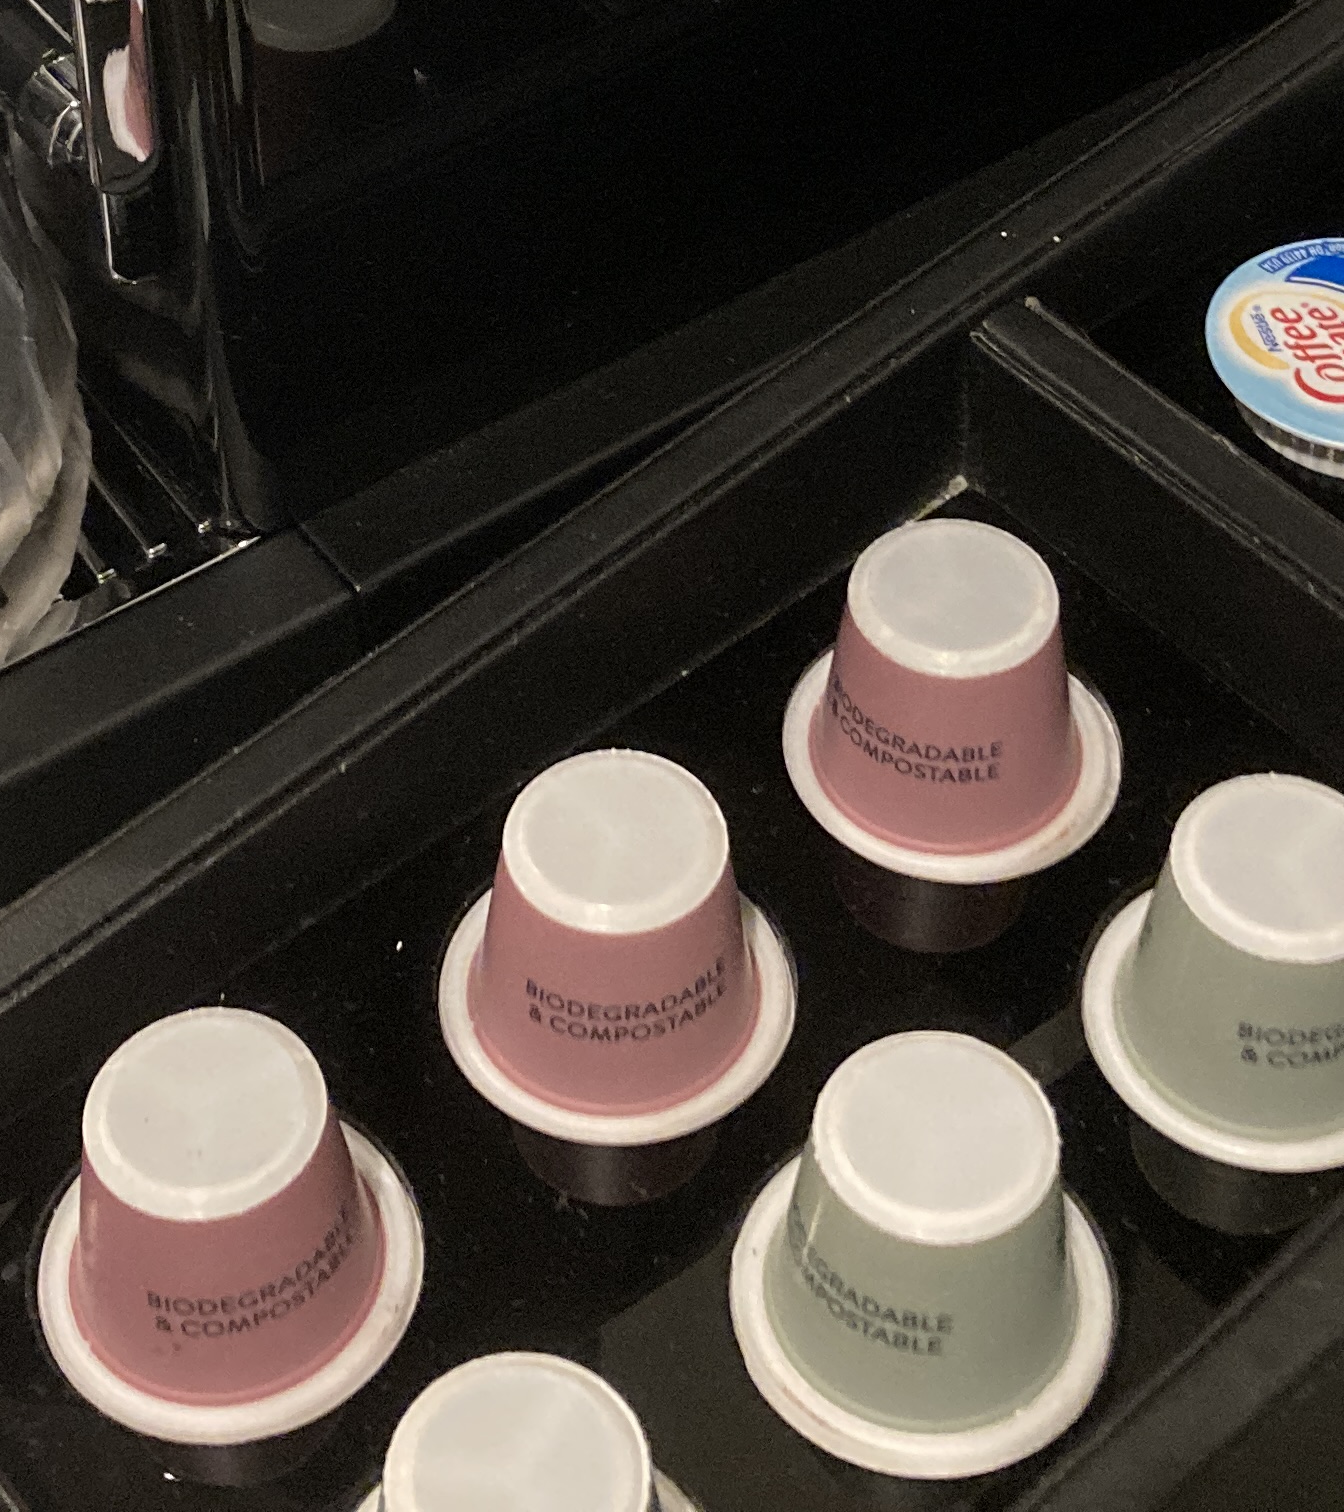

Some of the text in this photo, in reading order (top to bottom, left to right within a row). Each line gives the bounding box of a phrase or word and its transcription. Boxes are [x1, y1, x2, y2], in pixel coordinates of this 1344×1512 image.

[839, 715, 999, 783] COMPOSTABLE
[525, 956, 725, 1021] BIODEGRADABLE
[549, 984, 726, 1041] COMPOSTABLE
